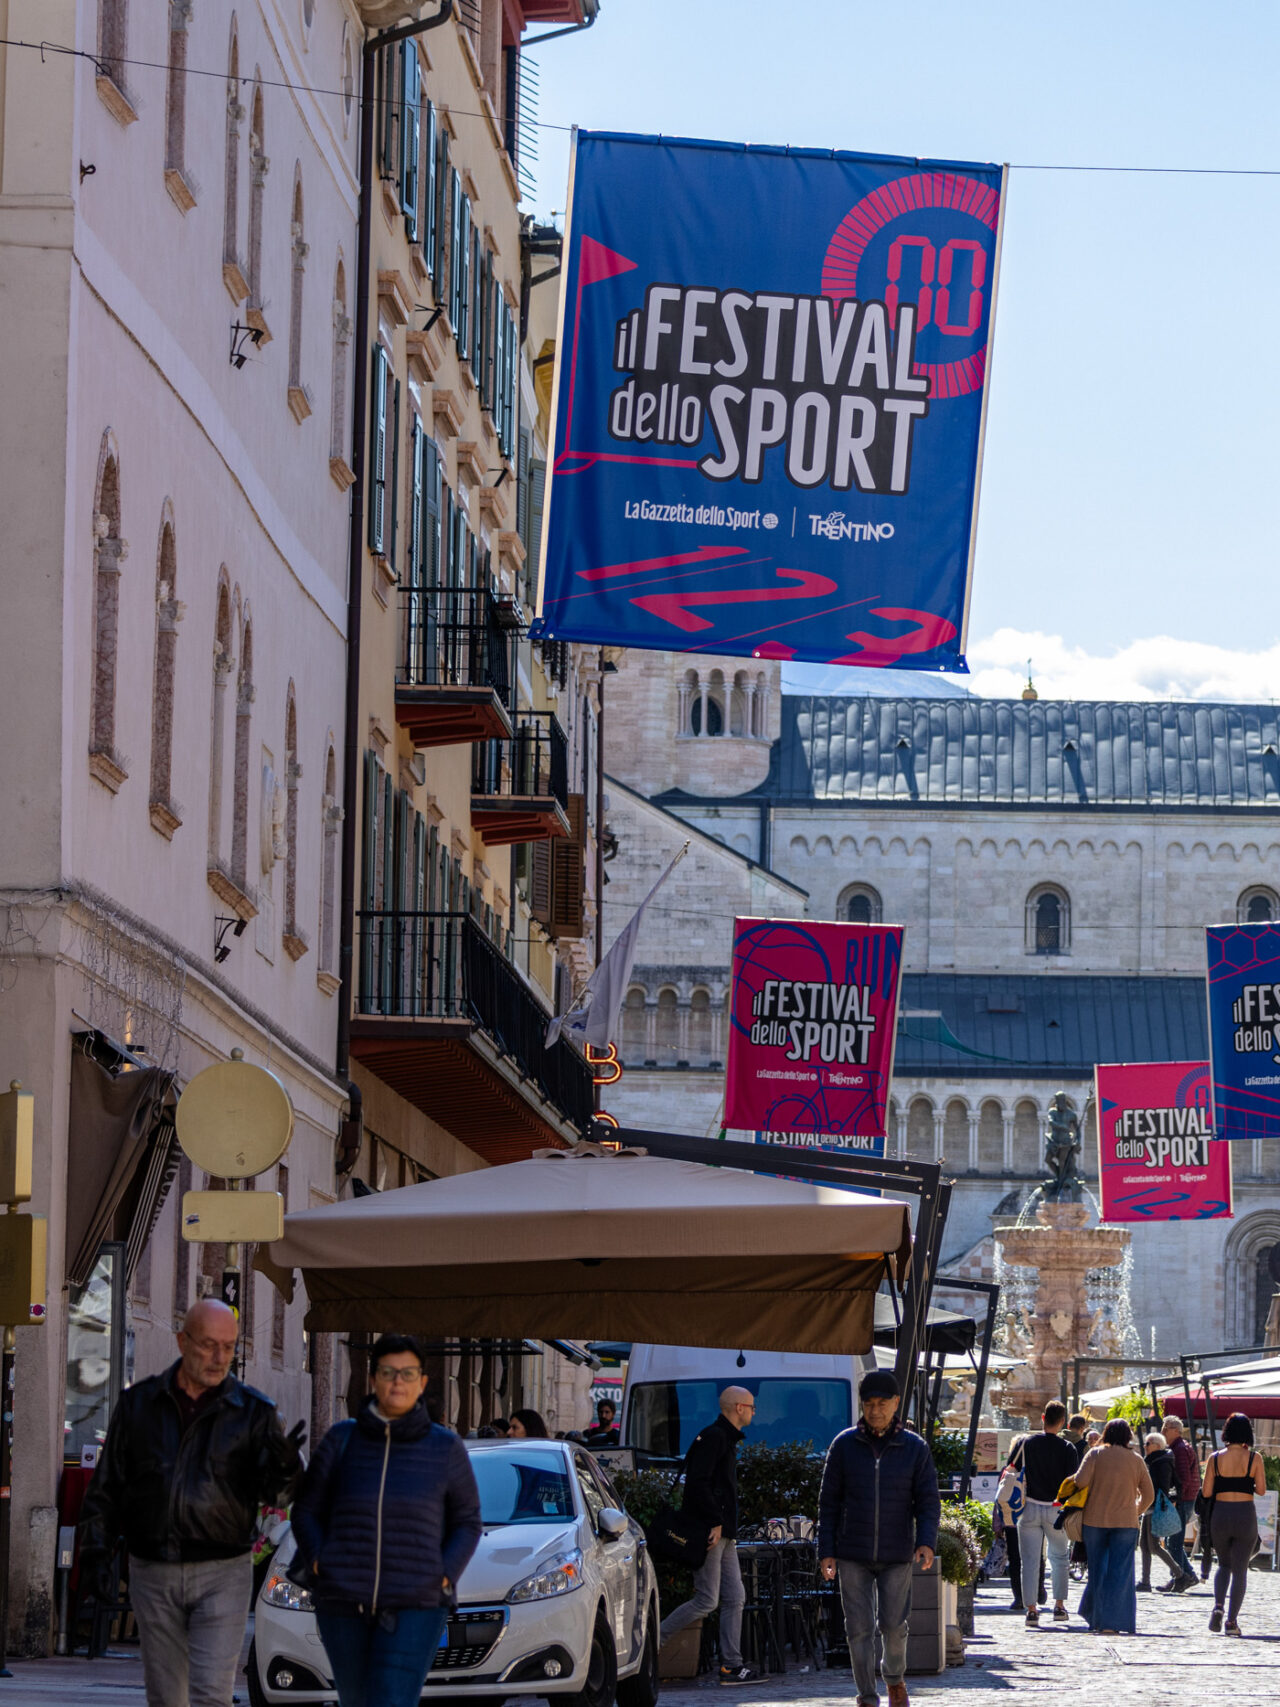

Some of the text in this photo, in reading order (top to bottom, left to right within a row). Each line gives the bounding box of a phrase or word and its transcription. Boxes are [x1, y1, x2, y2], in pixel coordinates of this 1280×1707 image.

[617, 286, 927, 393] il FESTIVAL
[612, 380, 927, 493] dello SPORT
[808, 513, 895, 543] TRENTINO
[752, 980, 875, 1023] il FESTIVAL
[1233, 998, 1243, 1023] il
[750, 1020, 876, 1065] dello SPORT
[1234, 1026, 1272, 1053] dello
[1115, 1107, 1212, 1137] il FESTIVAL
[766, 1131, 822, 1148] FESTIVAL
[838, 1135, 875, 1150] SPORT
[1116, 1135, 1212, 1168] dello SPORT
